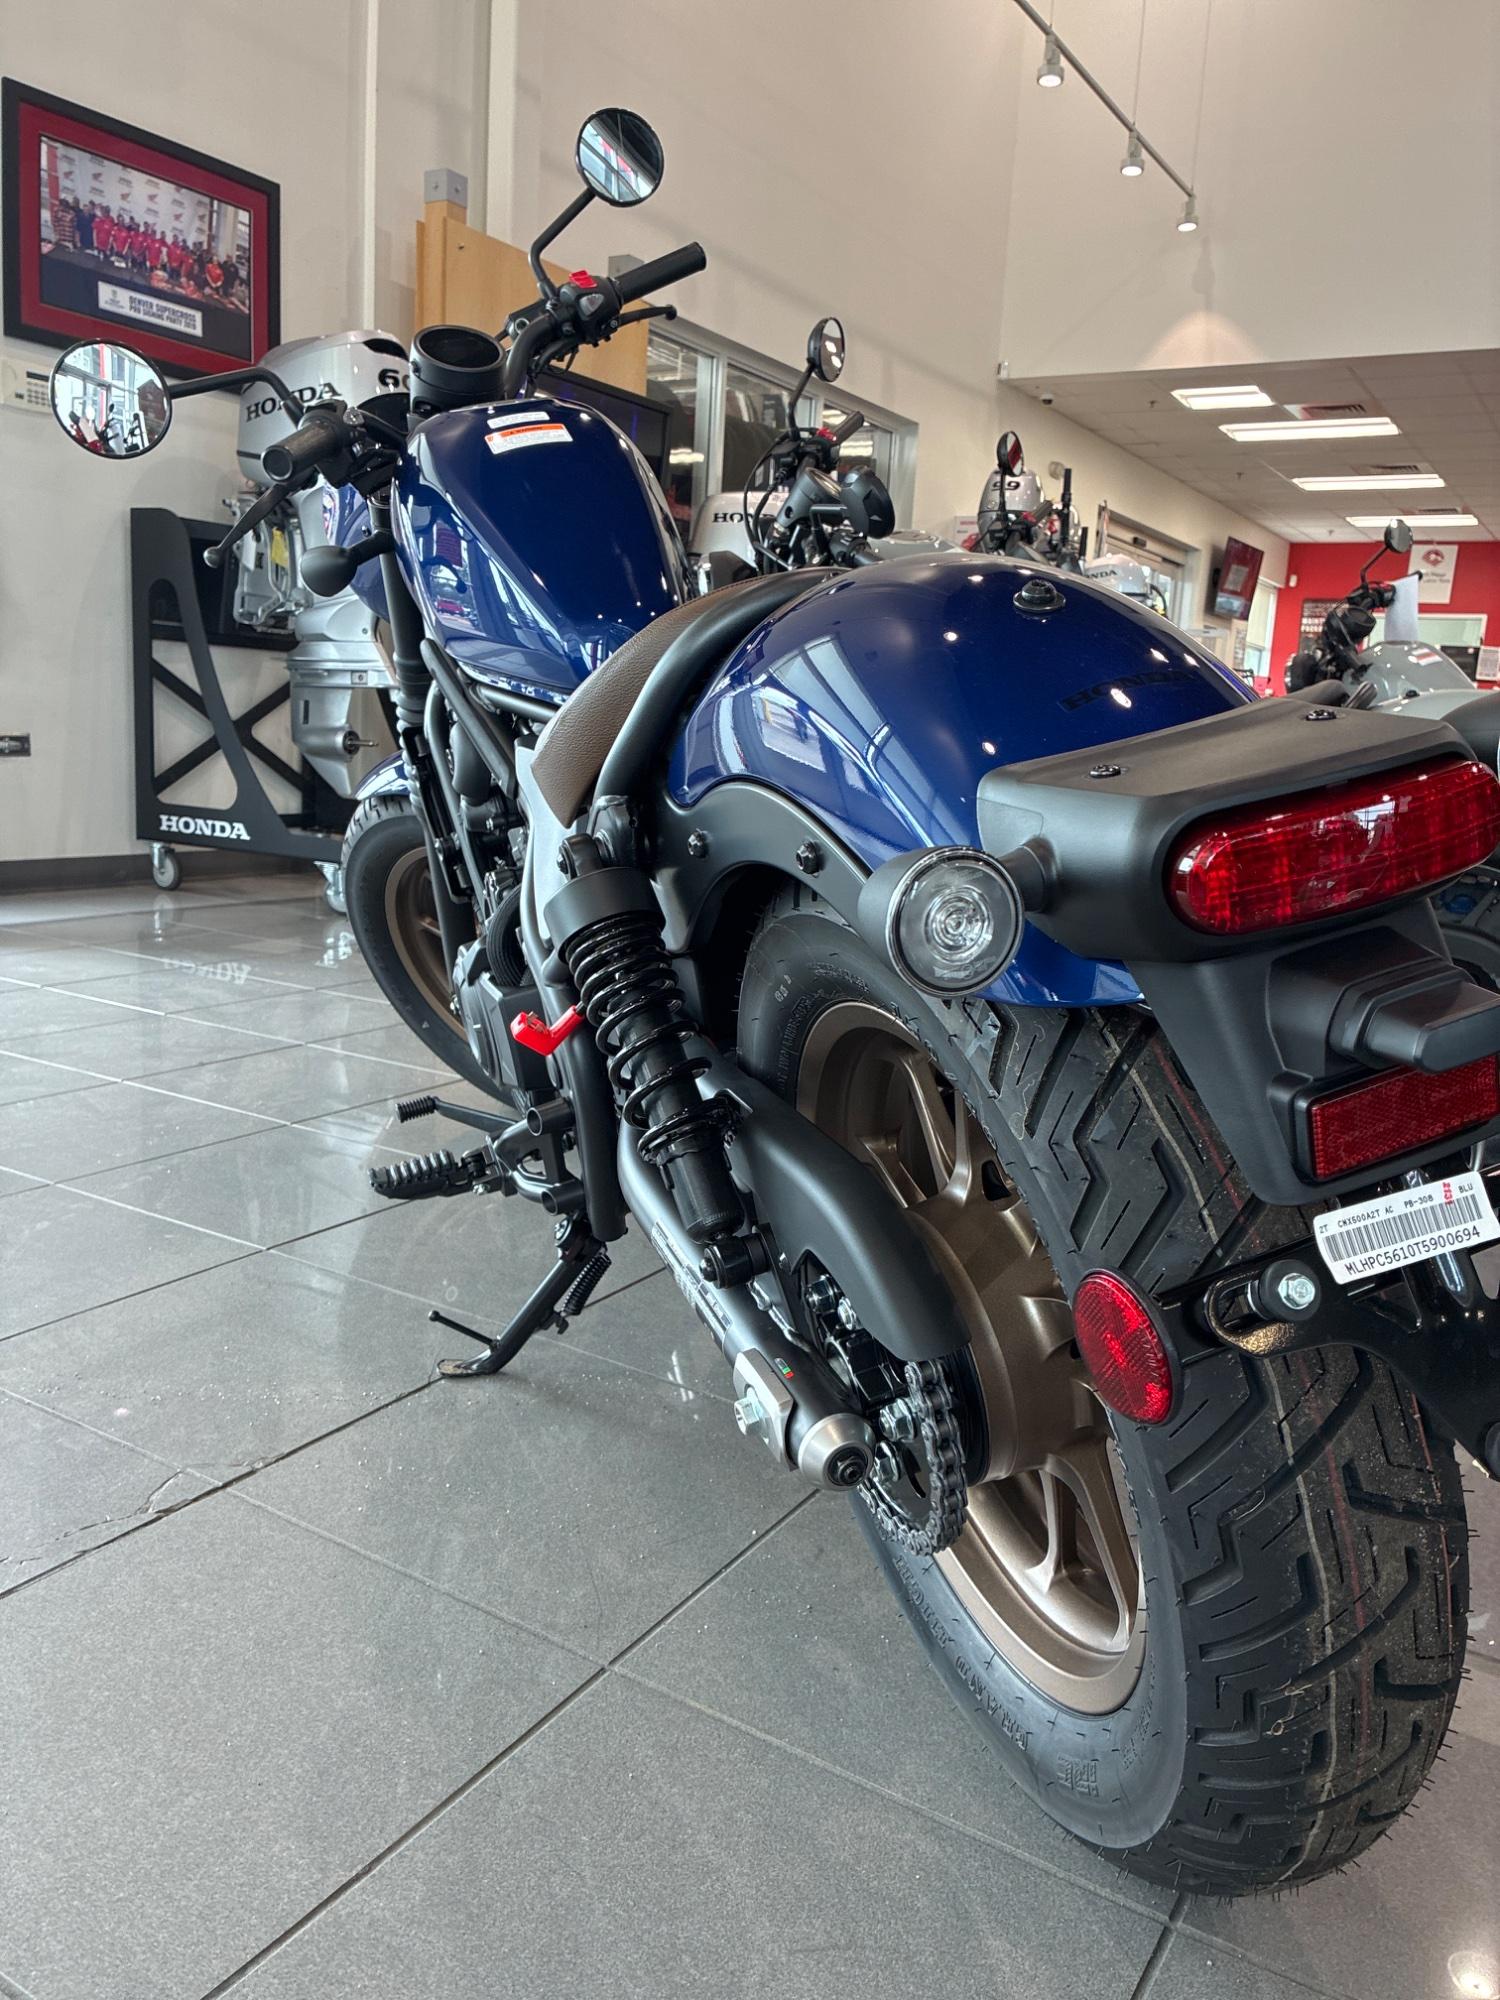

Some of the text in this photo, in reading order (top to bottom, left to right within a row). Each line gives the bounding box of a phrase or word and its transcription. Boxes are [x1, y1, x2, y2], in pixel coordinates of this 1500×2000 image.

[155, 302, 197, 322] SUPERCROSS
[159, 814, 251, 841] HONDA
[1384, 1205, 1395, 1216] AC
[1403, 1193, 1435, 1210] PB-308
[1458, 1182, 1475, 1194] BLU
[1344, 1225, 1481, 1276] MLHPC5610T5900694
